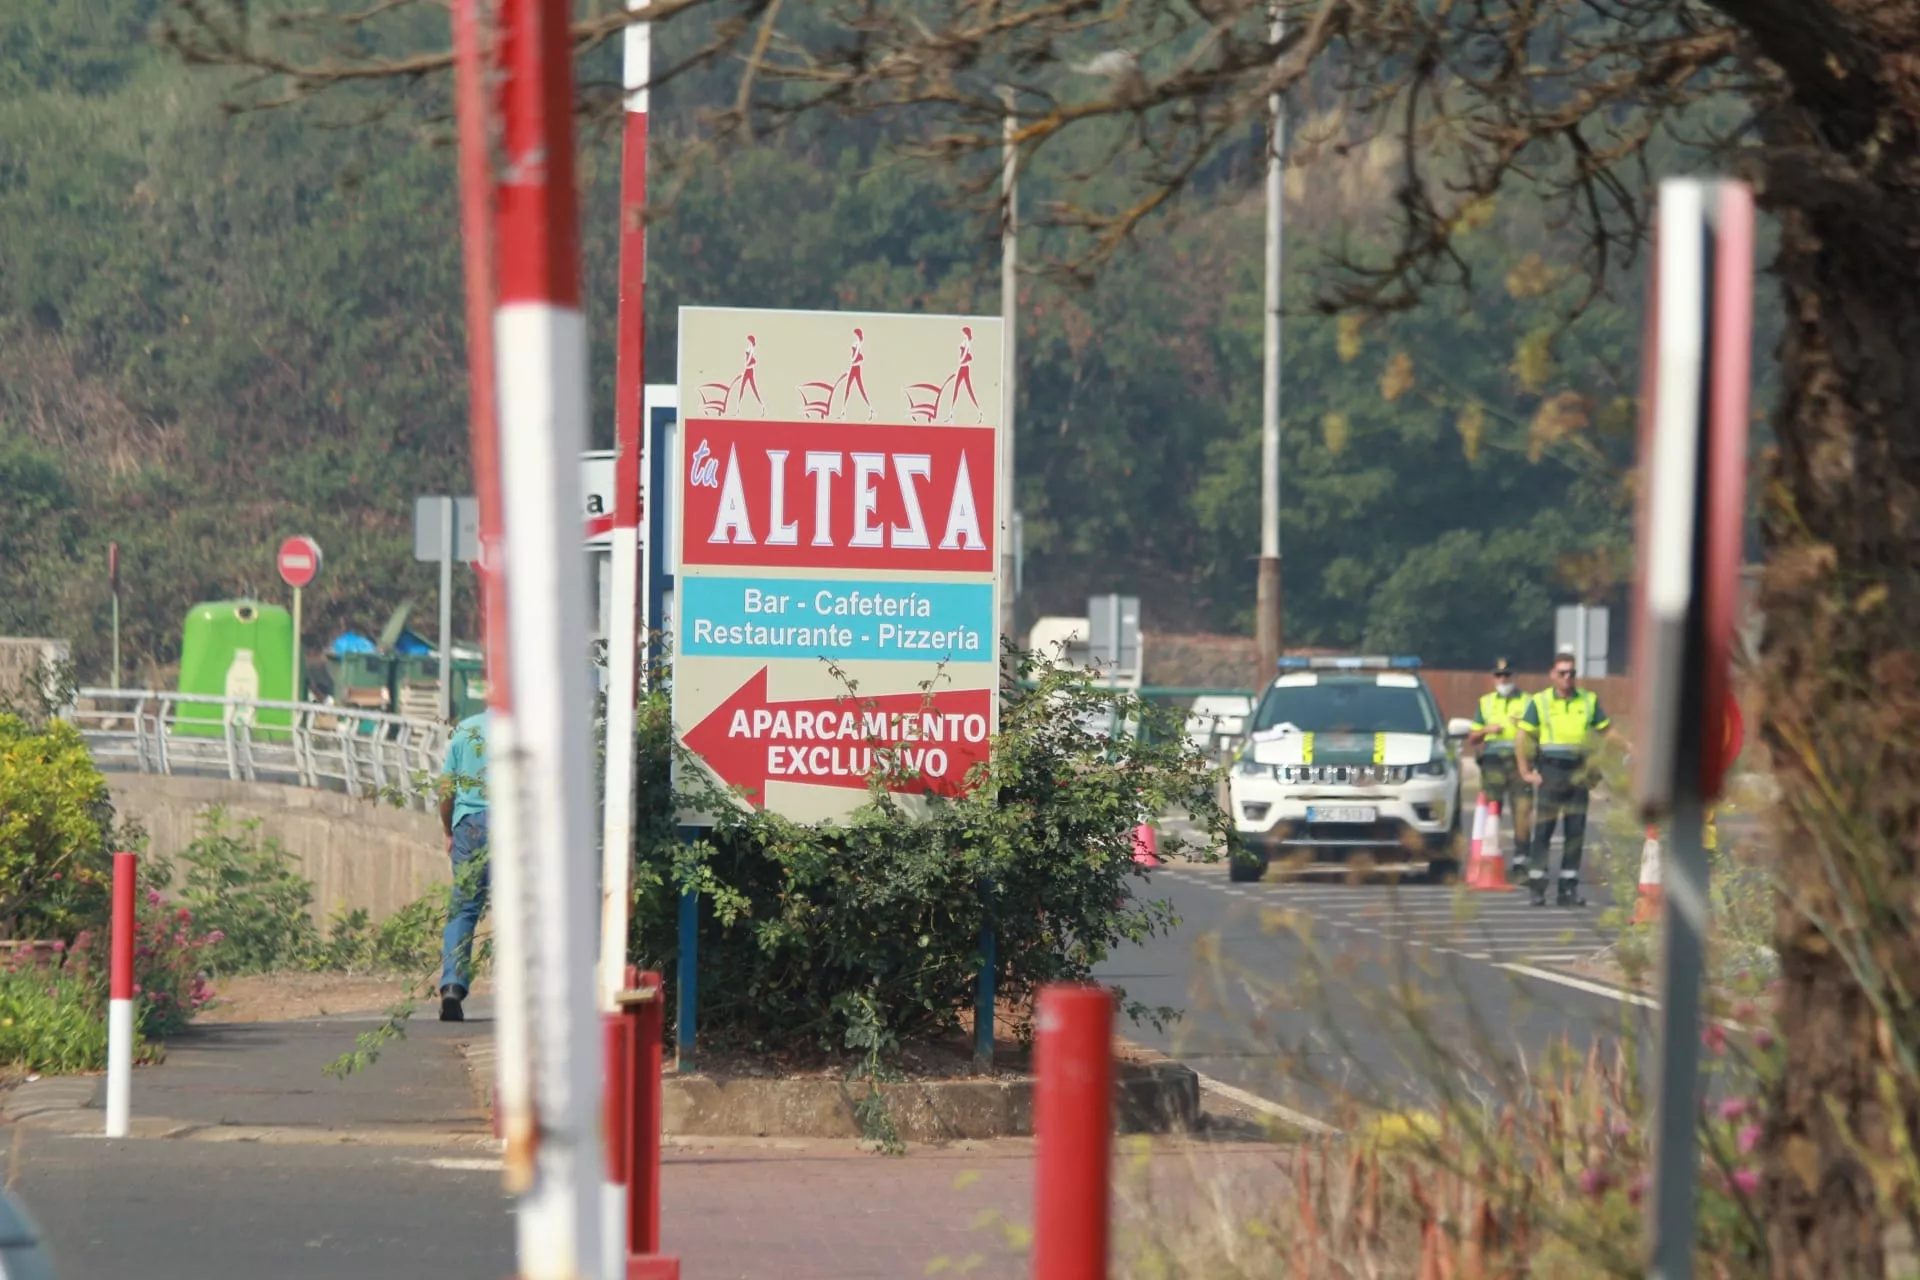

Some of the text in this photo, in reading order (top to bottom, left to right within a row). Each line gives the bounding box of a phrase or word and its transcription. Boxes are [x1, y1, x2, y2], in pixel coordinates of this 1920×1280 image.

[707, 442, 987, 551] ALTEZA
[744, 588, 790, 615] Bar
[814, 590, 931, 617] Cafetería
[693, 619, 853, 648] Restaurante
[878, 623, 980, 650] Pizzería
[727, 709, 987, 743] APARCAMIENTO
[767, 745, 949, 778] EXCLUSIVO
